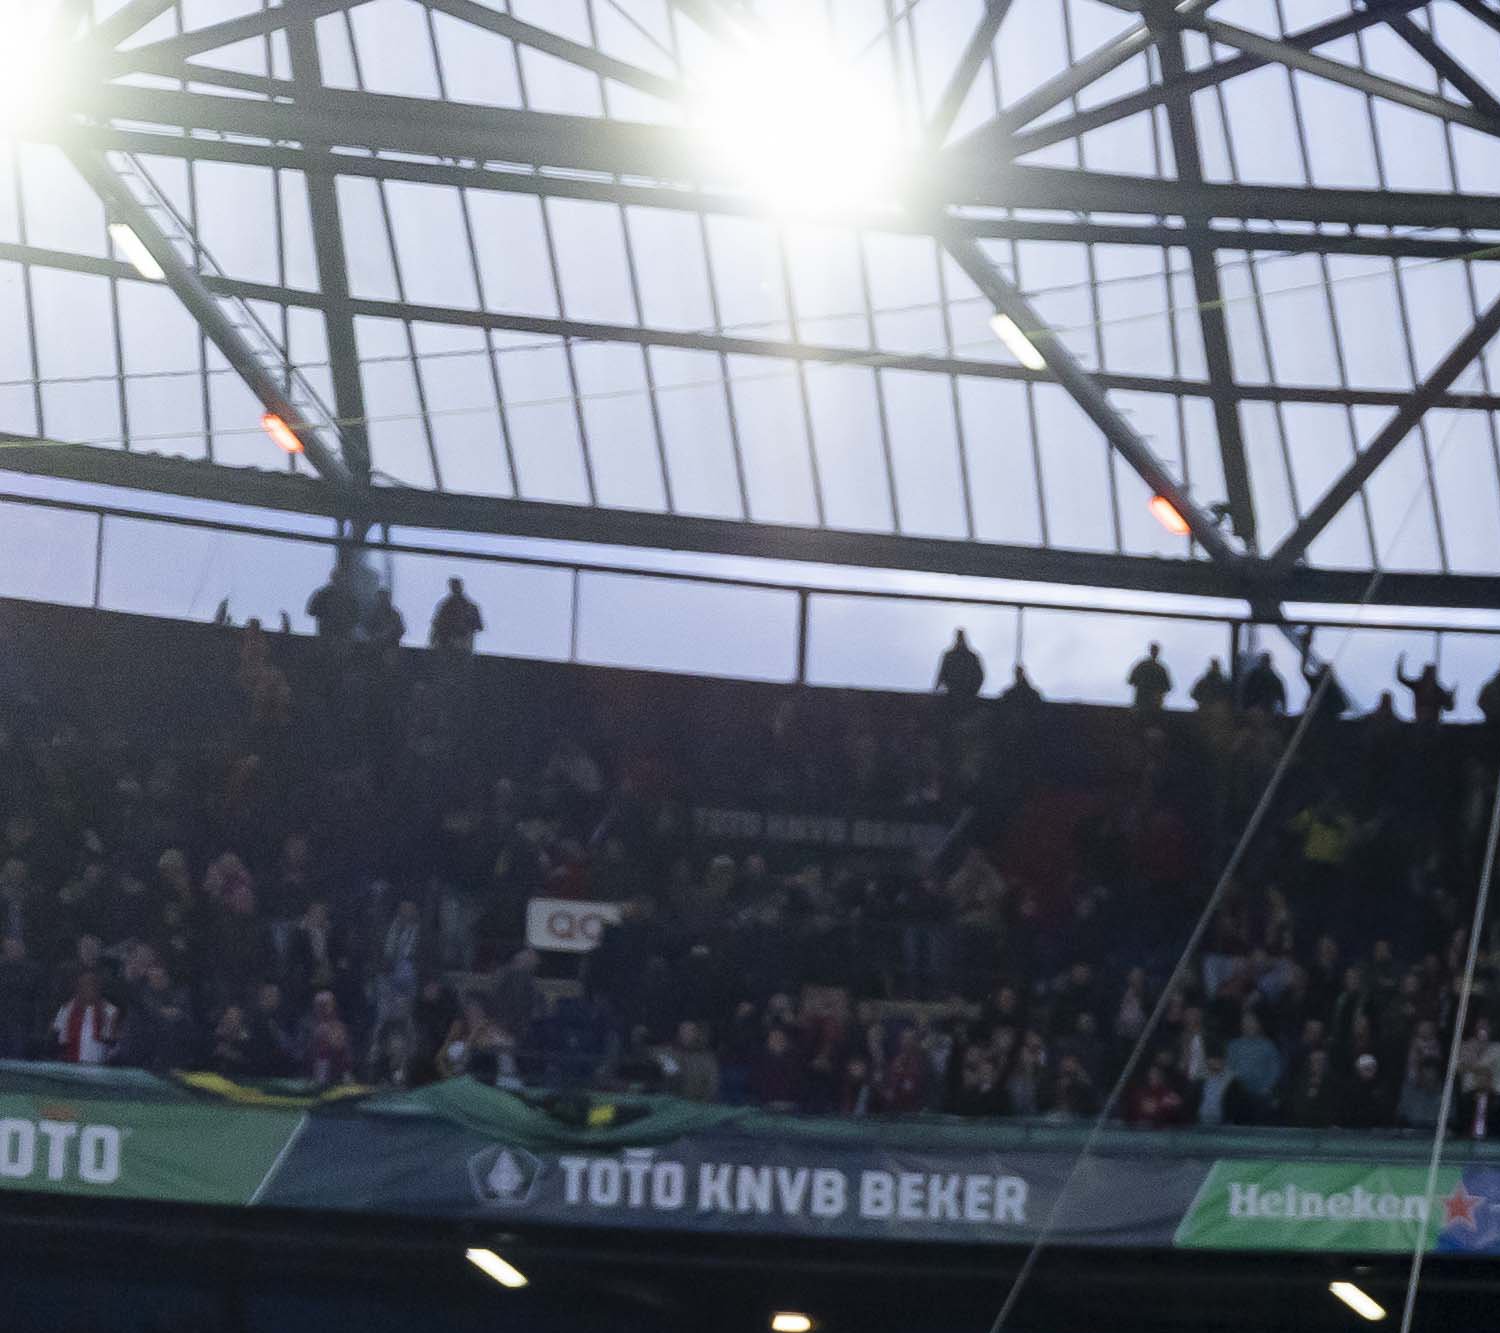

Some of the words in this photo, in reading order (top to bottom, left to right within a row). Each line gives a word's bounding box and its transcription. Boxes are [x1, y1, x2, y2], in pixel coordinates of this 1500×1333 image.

[559, 1150, 687, 1211] TOTO
[697, 1161, 848, 1219] KNVB
[858, 1168, 1029, 1225] BEKER
[1228, 1182, 1430, 1222] Heineken
